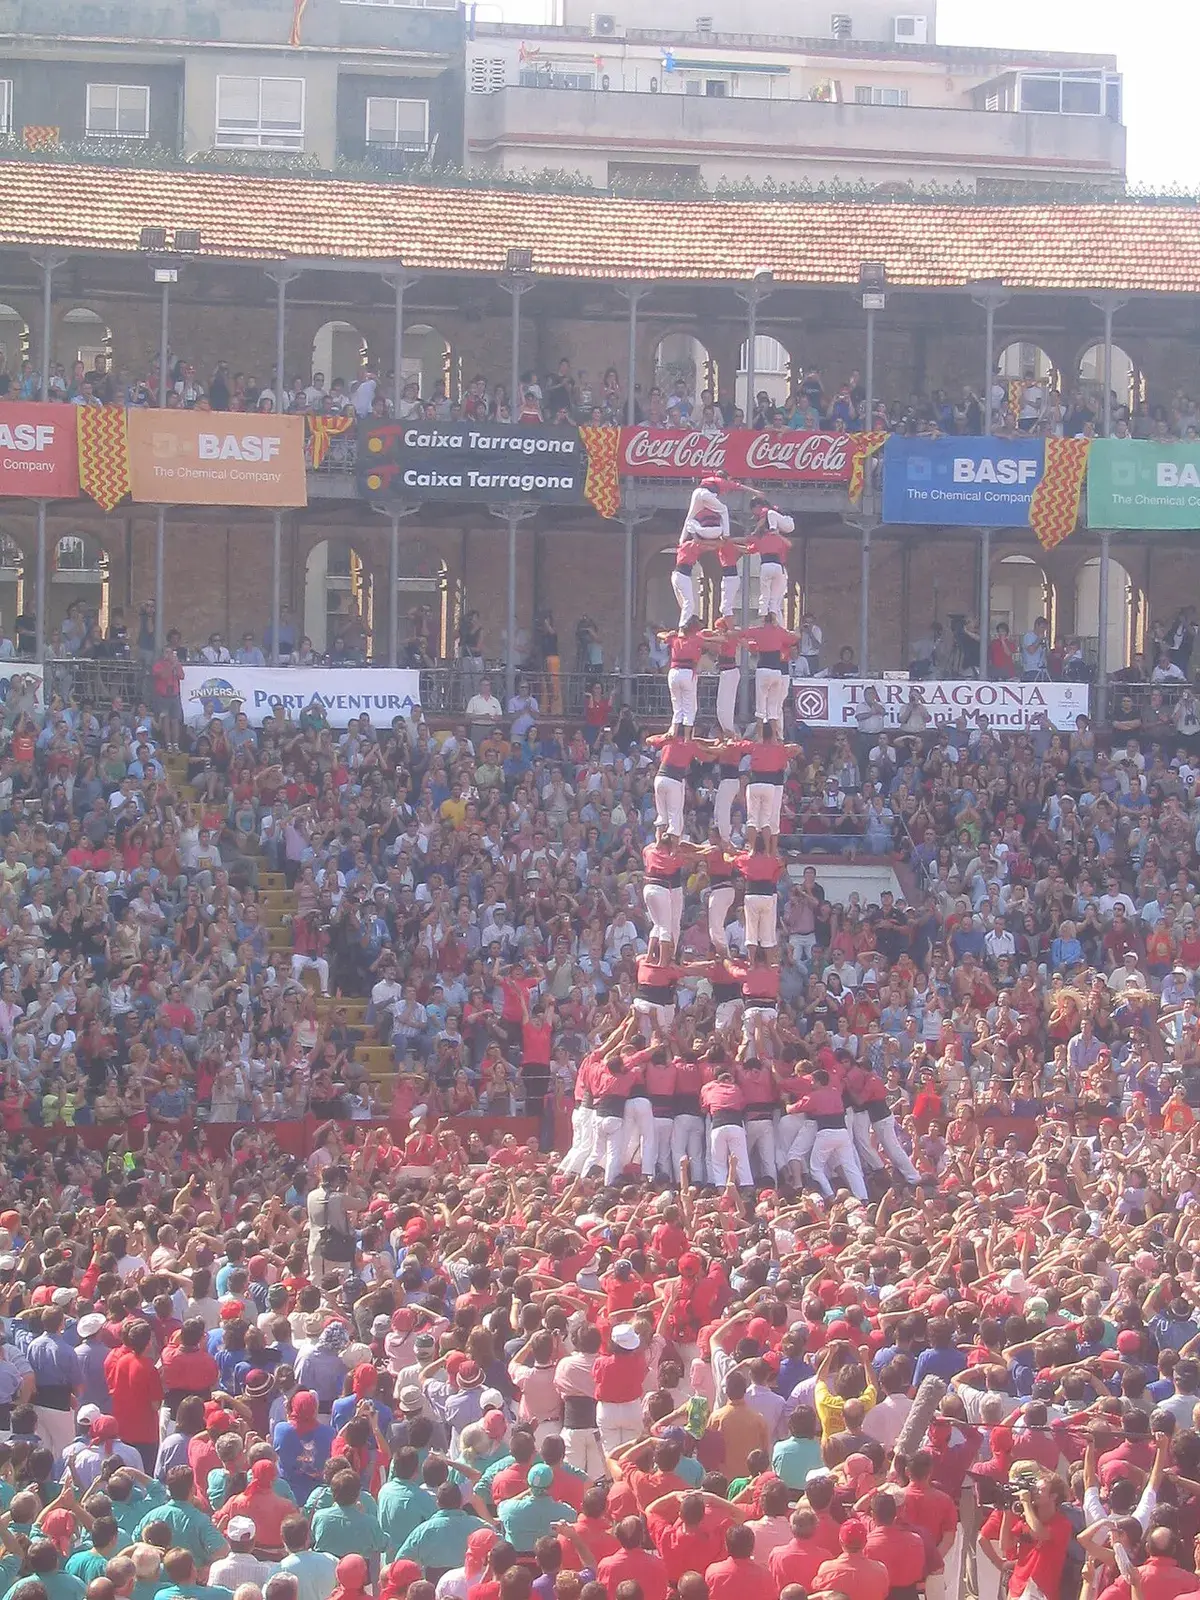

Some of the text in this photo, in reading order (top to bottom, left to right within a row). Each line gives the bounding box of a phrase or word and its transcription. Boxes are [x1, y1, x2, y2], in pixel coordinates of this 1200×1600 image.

[0, 424, 54, 451] ASF
[198, 434, 280, 462] BASF
[404, 429, 575, 454] Caixa Tarragona
[625, 430, 730, 467] Coca-Cola
[746, 434, 849, 470] Coca-Cola
[3, 458, 55, 473] Company
[153, 465, 281, 483] The Chemical Company
[953, 458, 1037, 485] BASF
[1156, 462, 1200, 488] BA
[403, 470, 574, 492] Caixa Tarragona
[907, 488, 1034, 504] The Chemical Compan
[1112, 493, 1132, 504] The
[1135, 494, 1184, 506] Chemical
[190, 687, 246, 698] UNIVERSAL
[254, 690, 414, 709] PORT AVENTURA
